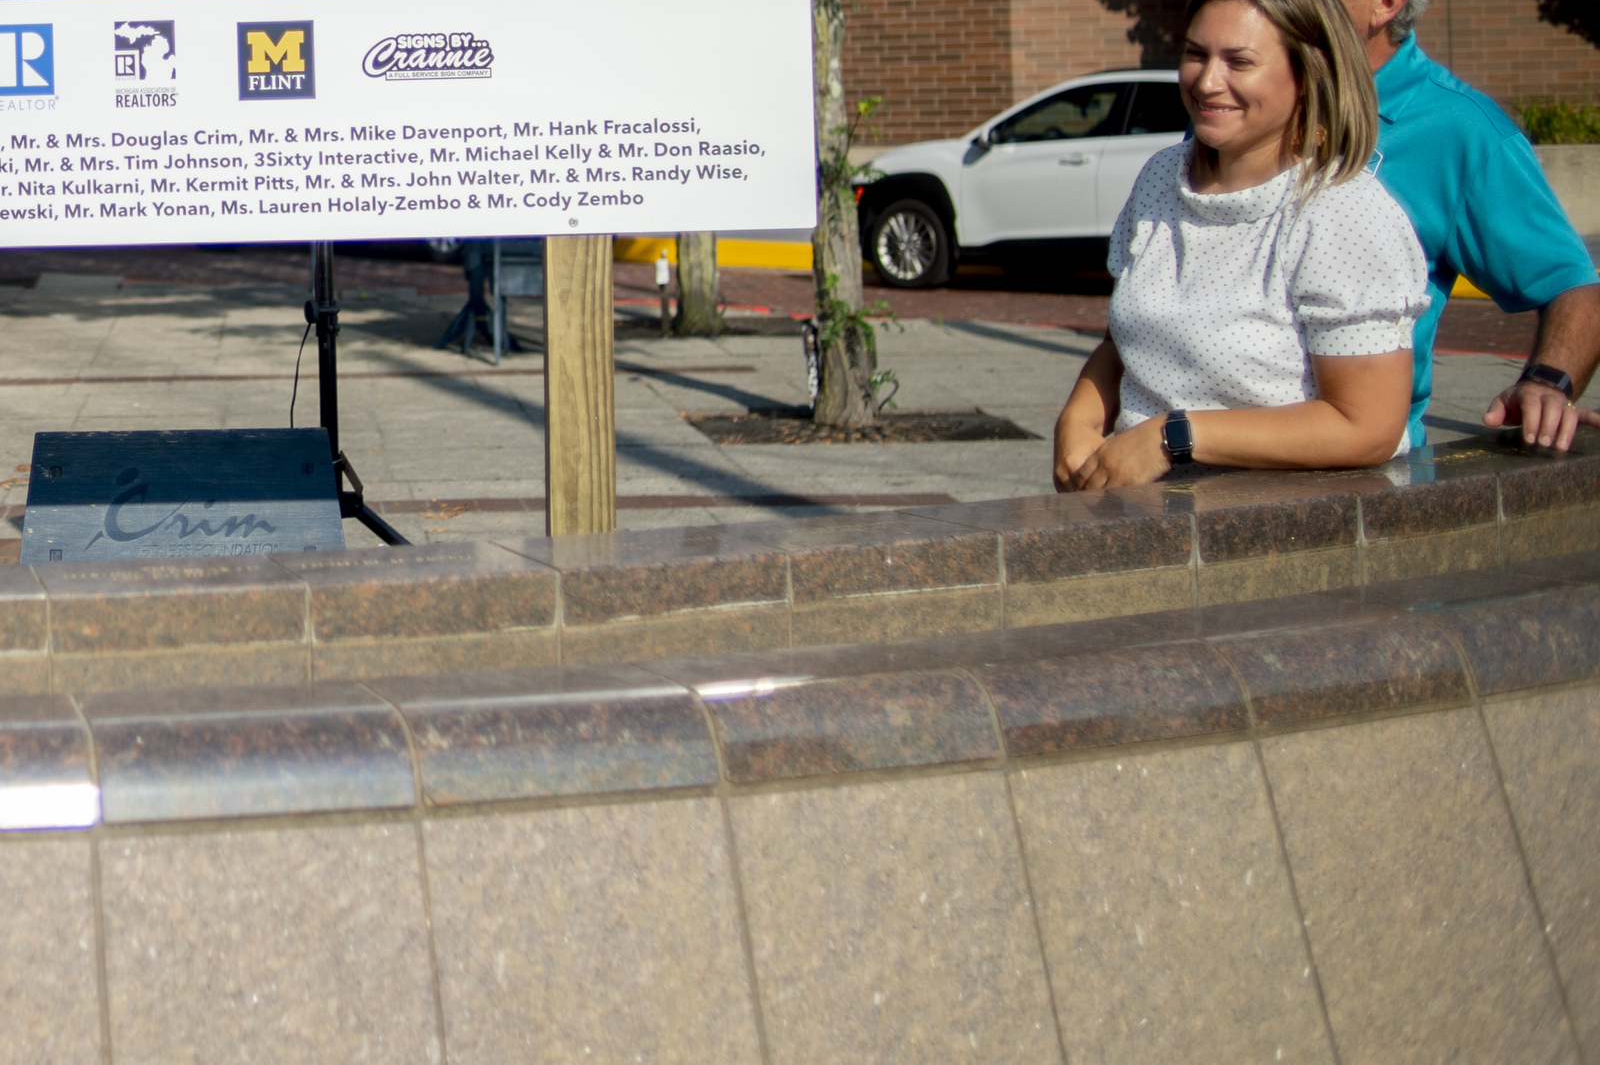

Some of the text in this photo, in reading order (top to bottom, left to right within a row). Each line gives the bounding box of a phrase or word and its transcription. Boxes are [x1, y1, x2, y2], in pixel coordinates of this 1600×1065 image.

[397, 35, 445, 49] SIGNS
[364, 38, 492, 77] Crannie
[249, 74, 305, 91] FLINT
[115, 93, 176, 108] REALTORS
[11, 135, 40, 149] Mr.
[46, 134, 59, 148] &
[67, 134, 105, 147] Mrs.
[112, 131, 188, 150] Douglas
[194, 130, 242, 146] Crim,
[250, 129, 278, 143] Mr.
[285, 128, 298, 142] &
[305, 128, 344, 142] Mrs.
[351, 125, 396, 140] Mike
[403, 125, 507, 142] Davenport,
[514, 123, 543, 136] Mr.
[550, 120, 597, 135] Hank
[604, 117, 700, 134] Fracalossi,
[25, 158, 54, 172] Mr.
[60, 157, 73, 171] &
[81, 157, 119, 170] Mrs.
[124, 155, 157, 169] Tim
[164, 154, 247, 169] Johnson,
[255, 152, 312, 170] 3Sixty
[319, 149, 423, 165] Interactive,
[431, 148, 459, 162] Mr.
[466, 145, 538, 161] Michael
[546, 144, 592, 163] Kelly
[598, 144, 611, 158] &
[619, 143, 648, 157] Mr.
[655, 143, 692, 156] Don
[699, 140, 765, 156] Raasio,
[19, 181, 55, 195] Nita
[63, 179, 144, 195] Kulkarni,
[151, 179, 180, 192] Mr.
[187, 176, 248, 192] Kermit
[255, 176, 299, 191] Pitts,
[306, 175, 334, 189] Mr.
[341, 174, 354, 188] &
[362, 174, 400, 187] Mrs.
[406, 171, 451, 186] John
[457, 170, 523, 186] Walter,
[531, 169, 559, 183] Mr.
[566, 168, 579, 182] &
[587, 168, 626, 182] Mrs.
[633, 165, 690, 184] Randy
[696, 164, 747, 180] Wise,
[65, 204, 93, 218] Mr.
[100, 202, 147, 217] Mark
[153, 202, 214, 217] Yonan,
[222, 201, 253, 214] Ms.
[260, 200, 321, 213] Lauren
[329, 195, 460, 215] Holaly-Zembo
[468, 194, 481, 209] &
[488, 194, 517, 208] Mr.
[523, 192, 571, 211] Cody
[578, 190, 643, 206] Zembo
